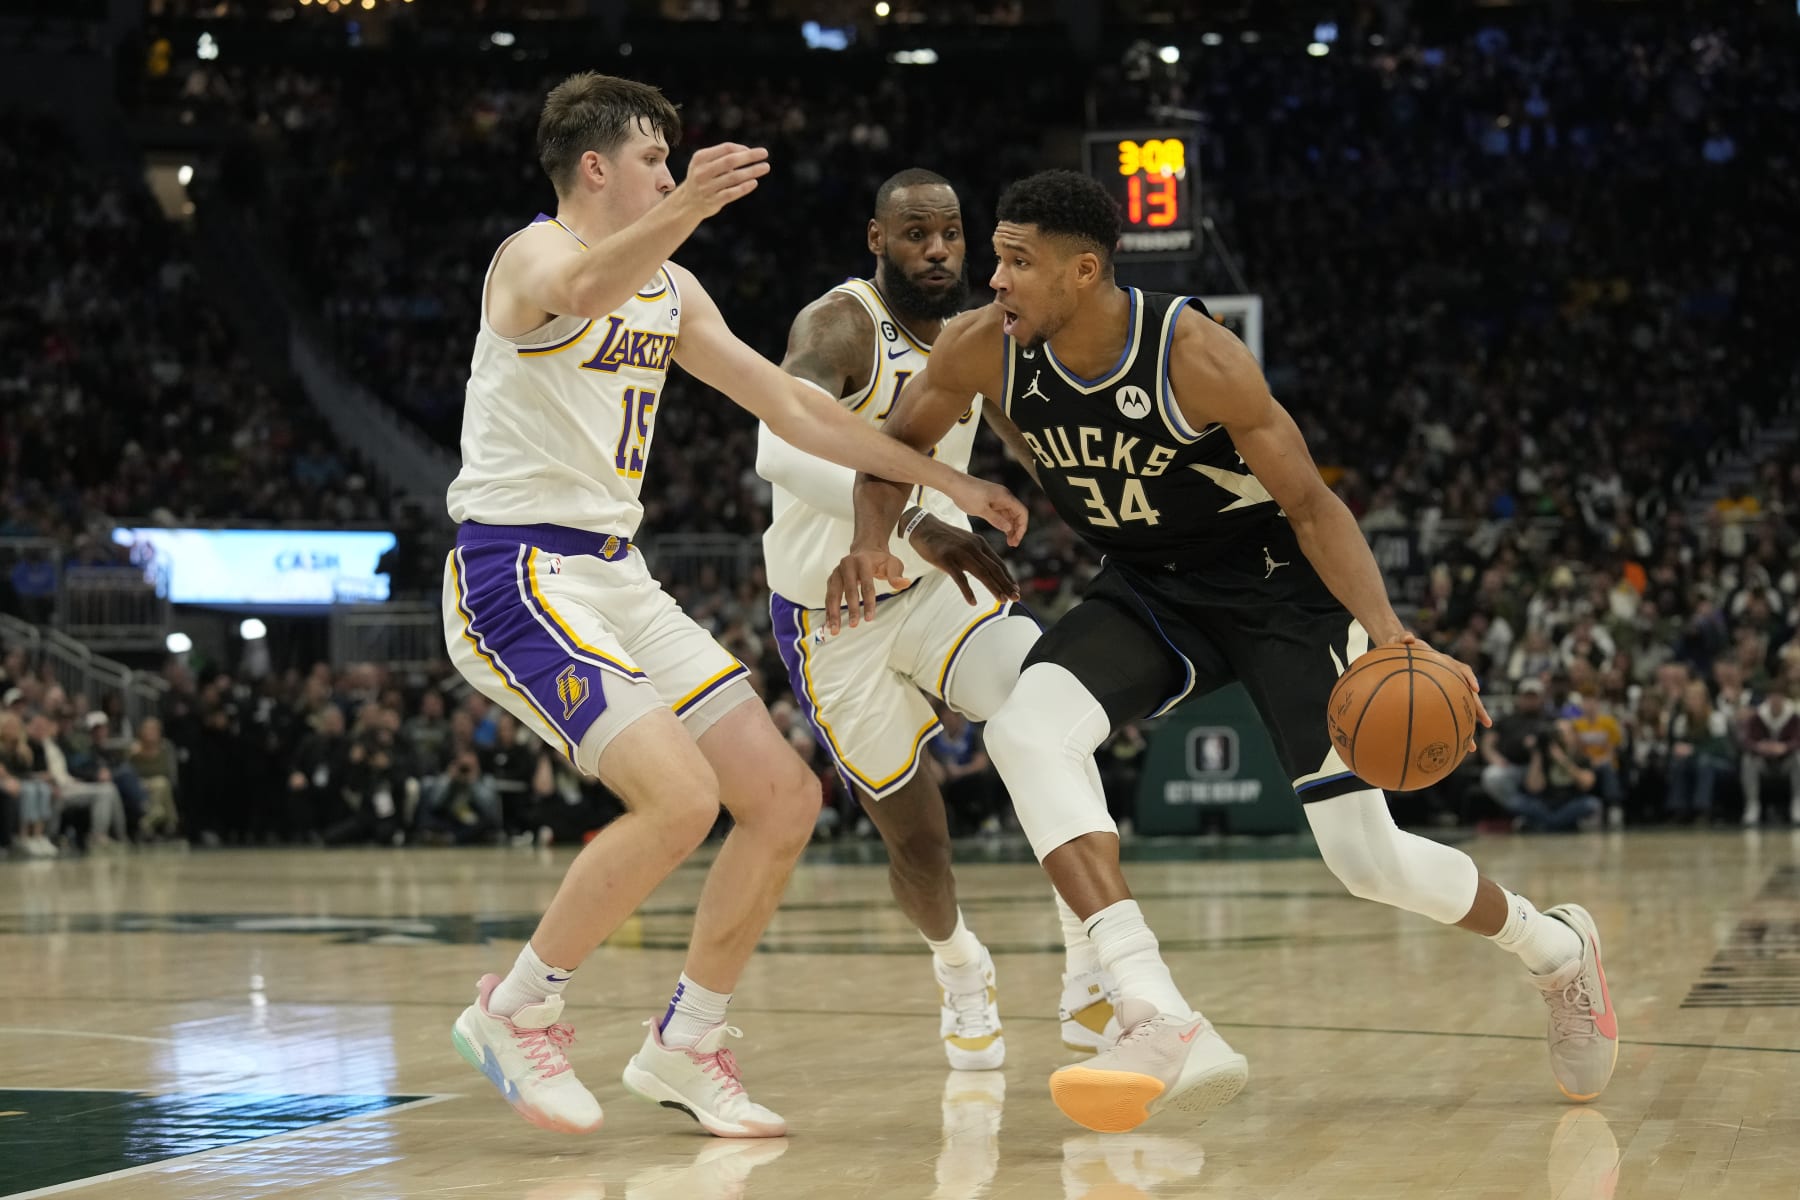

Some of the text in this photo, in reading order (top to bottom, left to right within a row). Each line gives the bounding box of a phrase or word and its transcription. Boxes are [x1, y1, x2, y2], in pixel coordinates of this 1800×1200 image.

[1128, 172, 1178, 227] 13
[881, 321, 898, 342] 6
[614, 385, 657, 479] 15
[1022, 425, 1178, 477] BUCKS
[1066, 476, 1161, 528] 34
